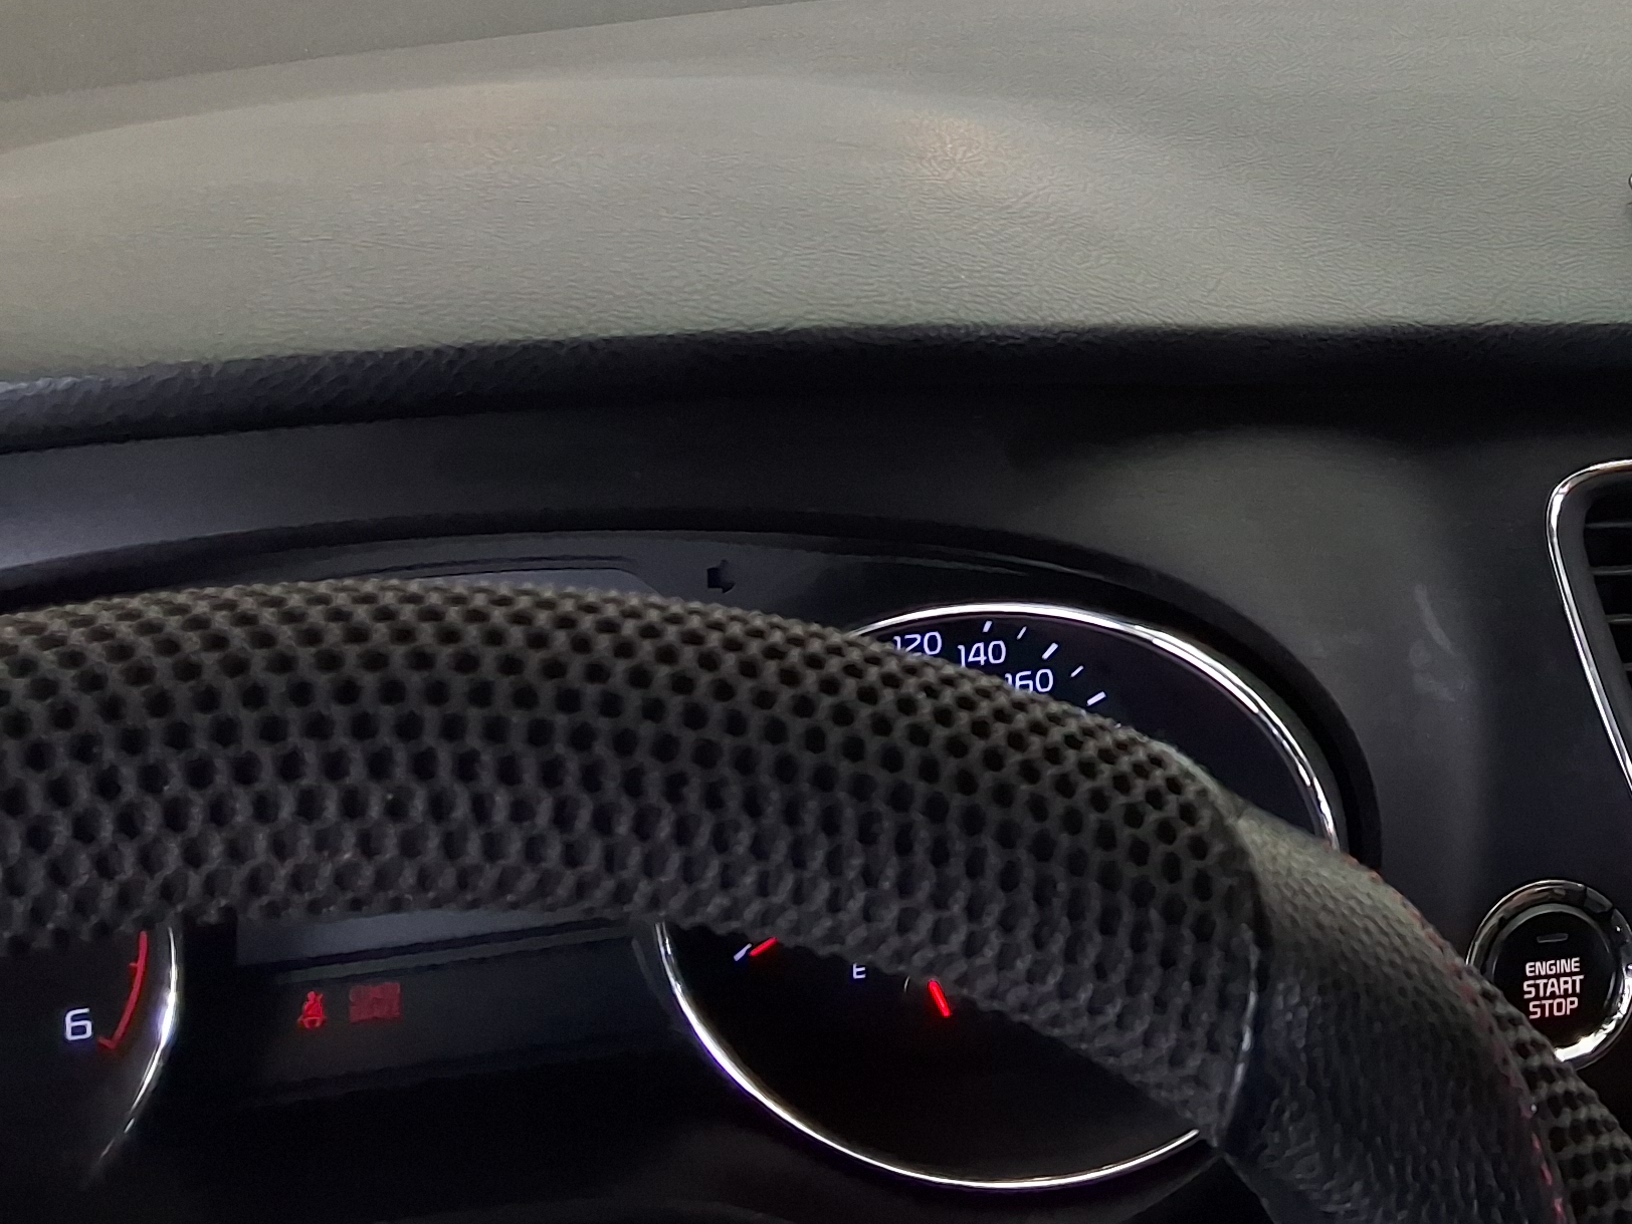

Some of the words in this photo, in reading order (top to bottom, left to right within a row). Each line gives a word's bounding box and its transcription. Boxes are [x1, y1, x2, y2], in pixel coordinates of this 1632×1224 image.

[957, 640, 1006, 668] 140
[1525, 957, 1581, 977] ENGINE
[1523, 975, 1585, 999] START
[1529, 997, 1579, 1019] STOP
[64, 1008, 93, 1041] 6
